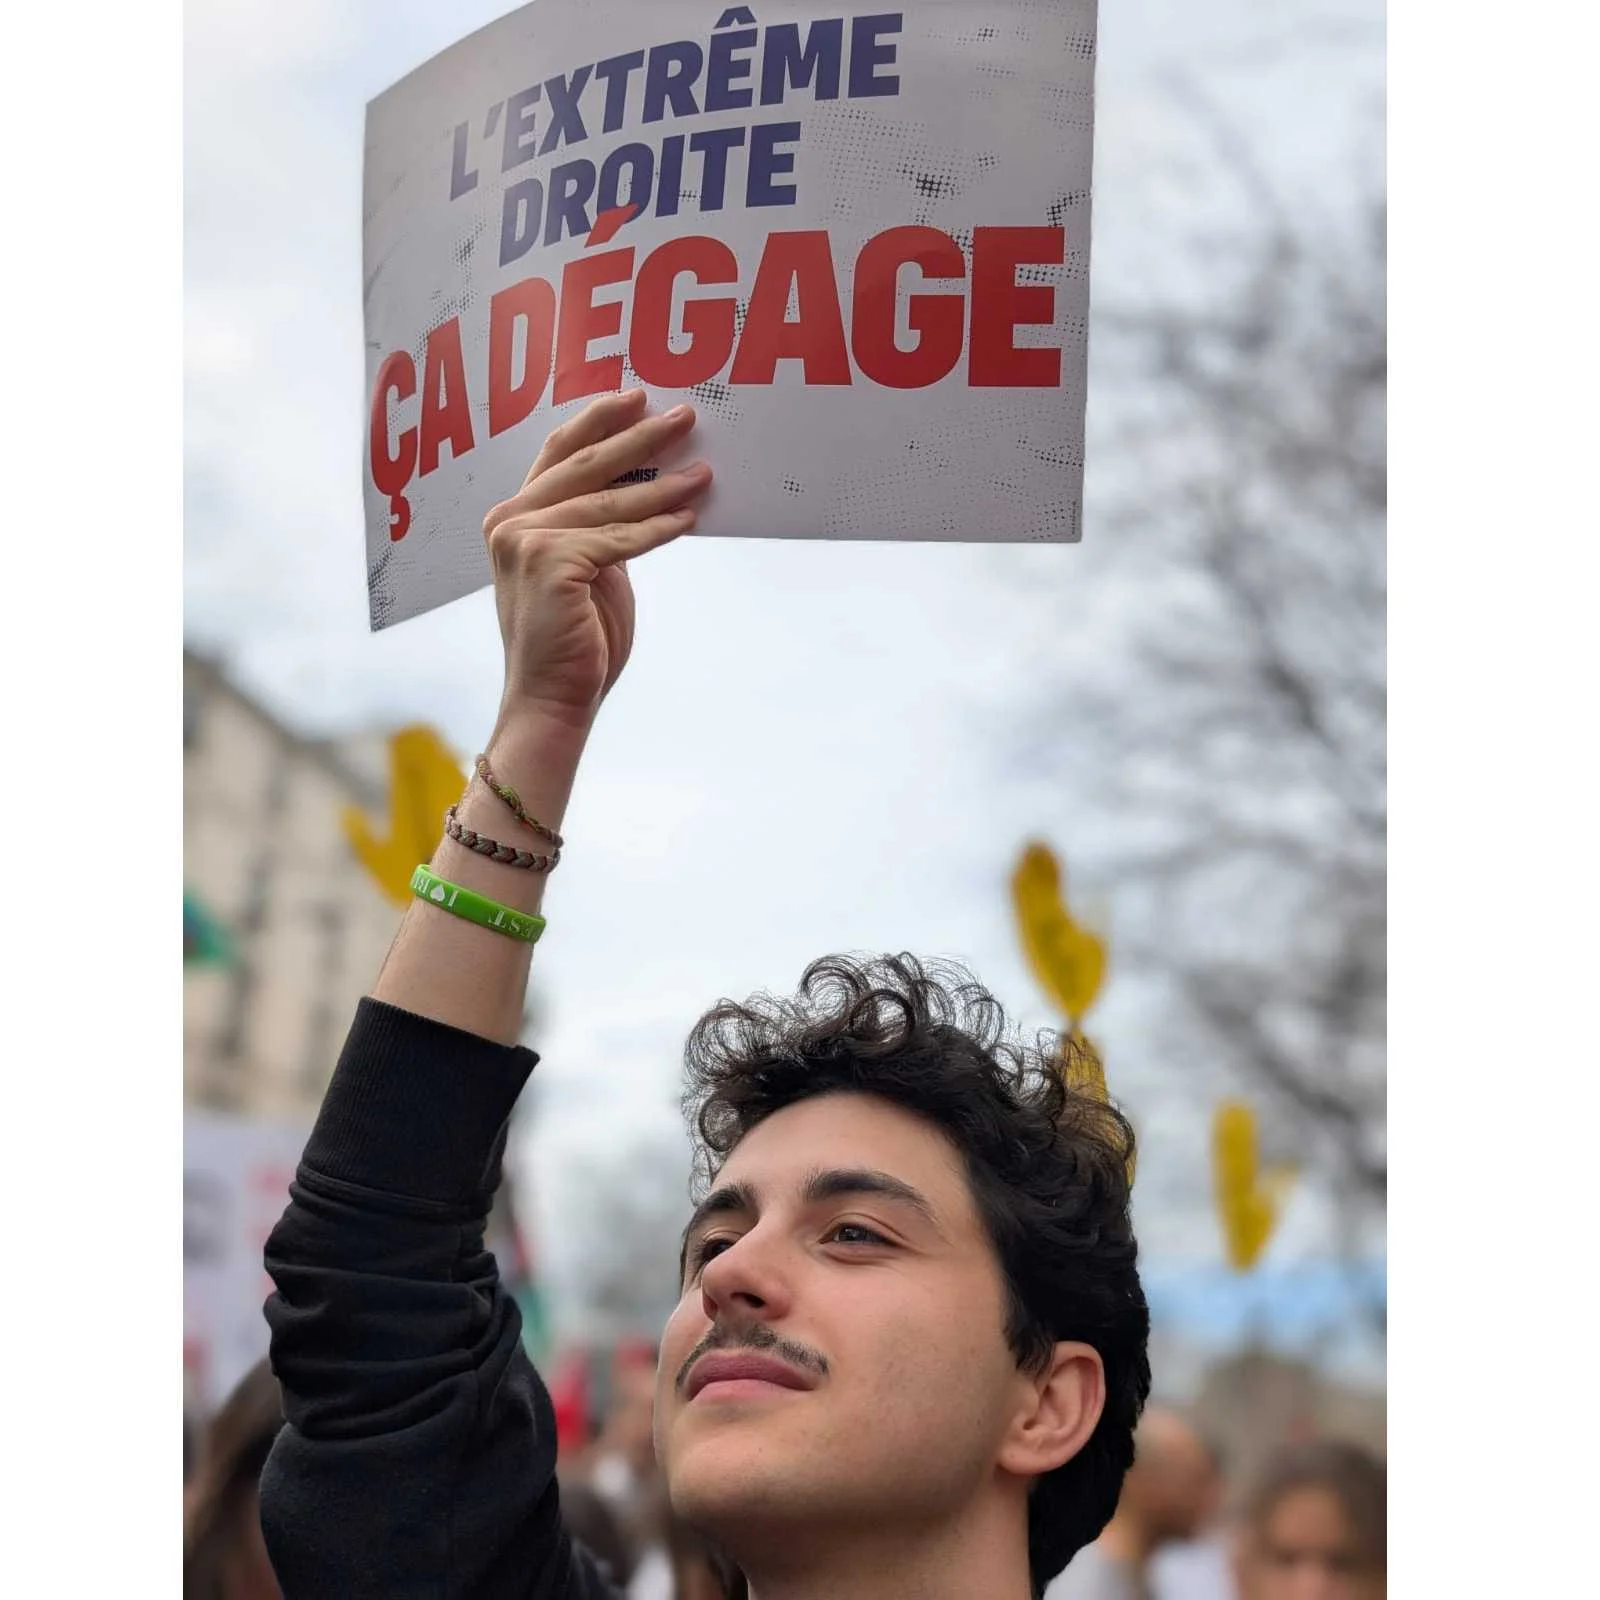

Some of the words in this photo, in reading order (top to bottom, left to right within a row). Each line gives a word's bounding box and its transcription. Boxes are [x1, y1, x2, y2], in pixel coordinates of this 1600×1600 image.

[450, 6, 903, 201] L'EXTRÊME
[499, 121, 802, 267] DROITE
[370, 316, 475, 541] ÇA
[488, 204, 1065, 437] DÉGAGE
